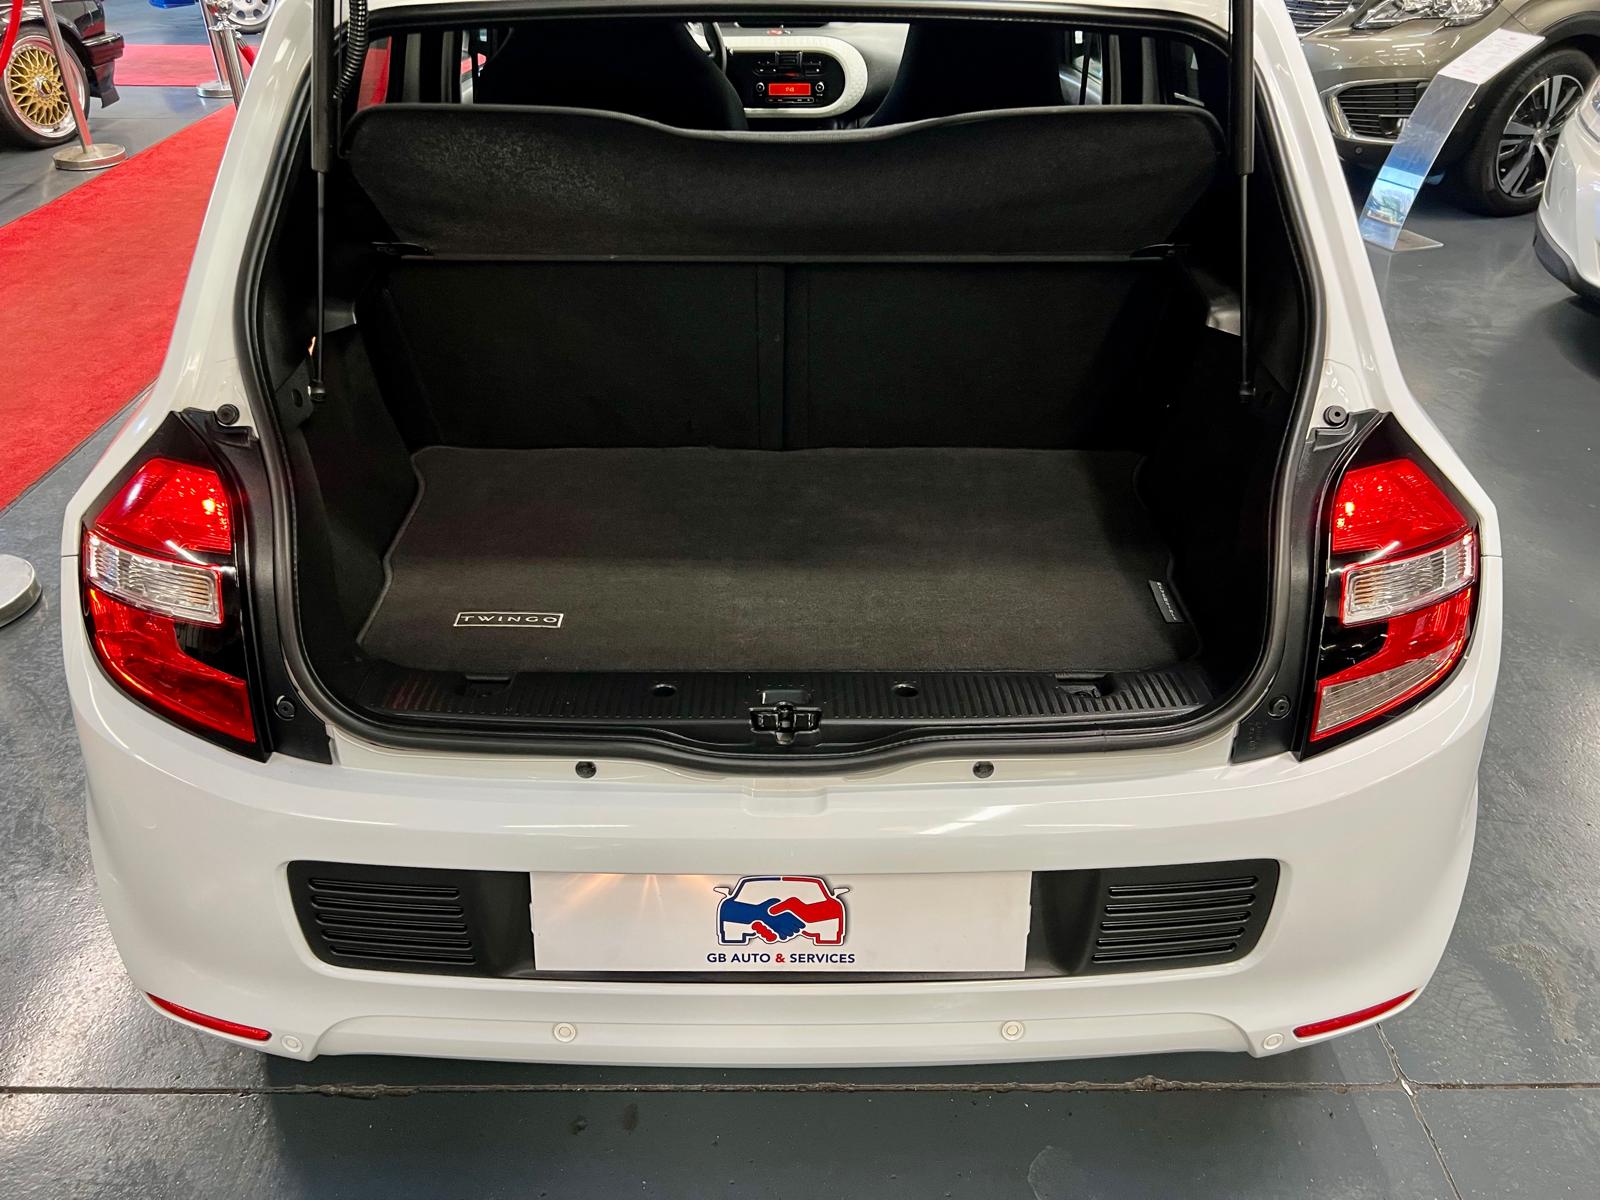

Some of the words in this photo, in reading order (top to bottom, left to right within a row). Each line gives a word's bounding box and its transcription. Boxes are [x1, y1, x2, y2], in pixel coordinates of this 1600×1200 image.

[460, 615, 558, 623] TWINGO
[706, 953, 727, 963] GB
[731, 953, 771, 963] AUTO
[775, 953, 786, 963] &
[789, 953, 856, 963] SERVICES
